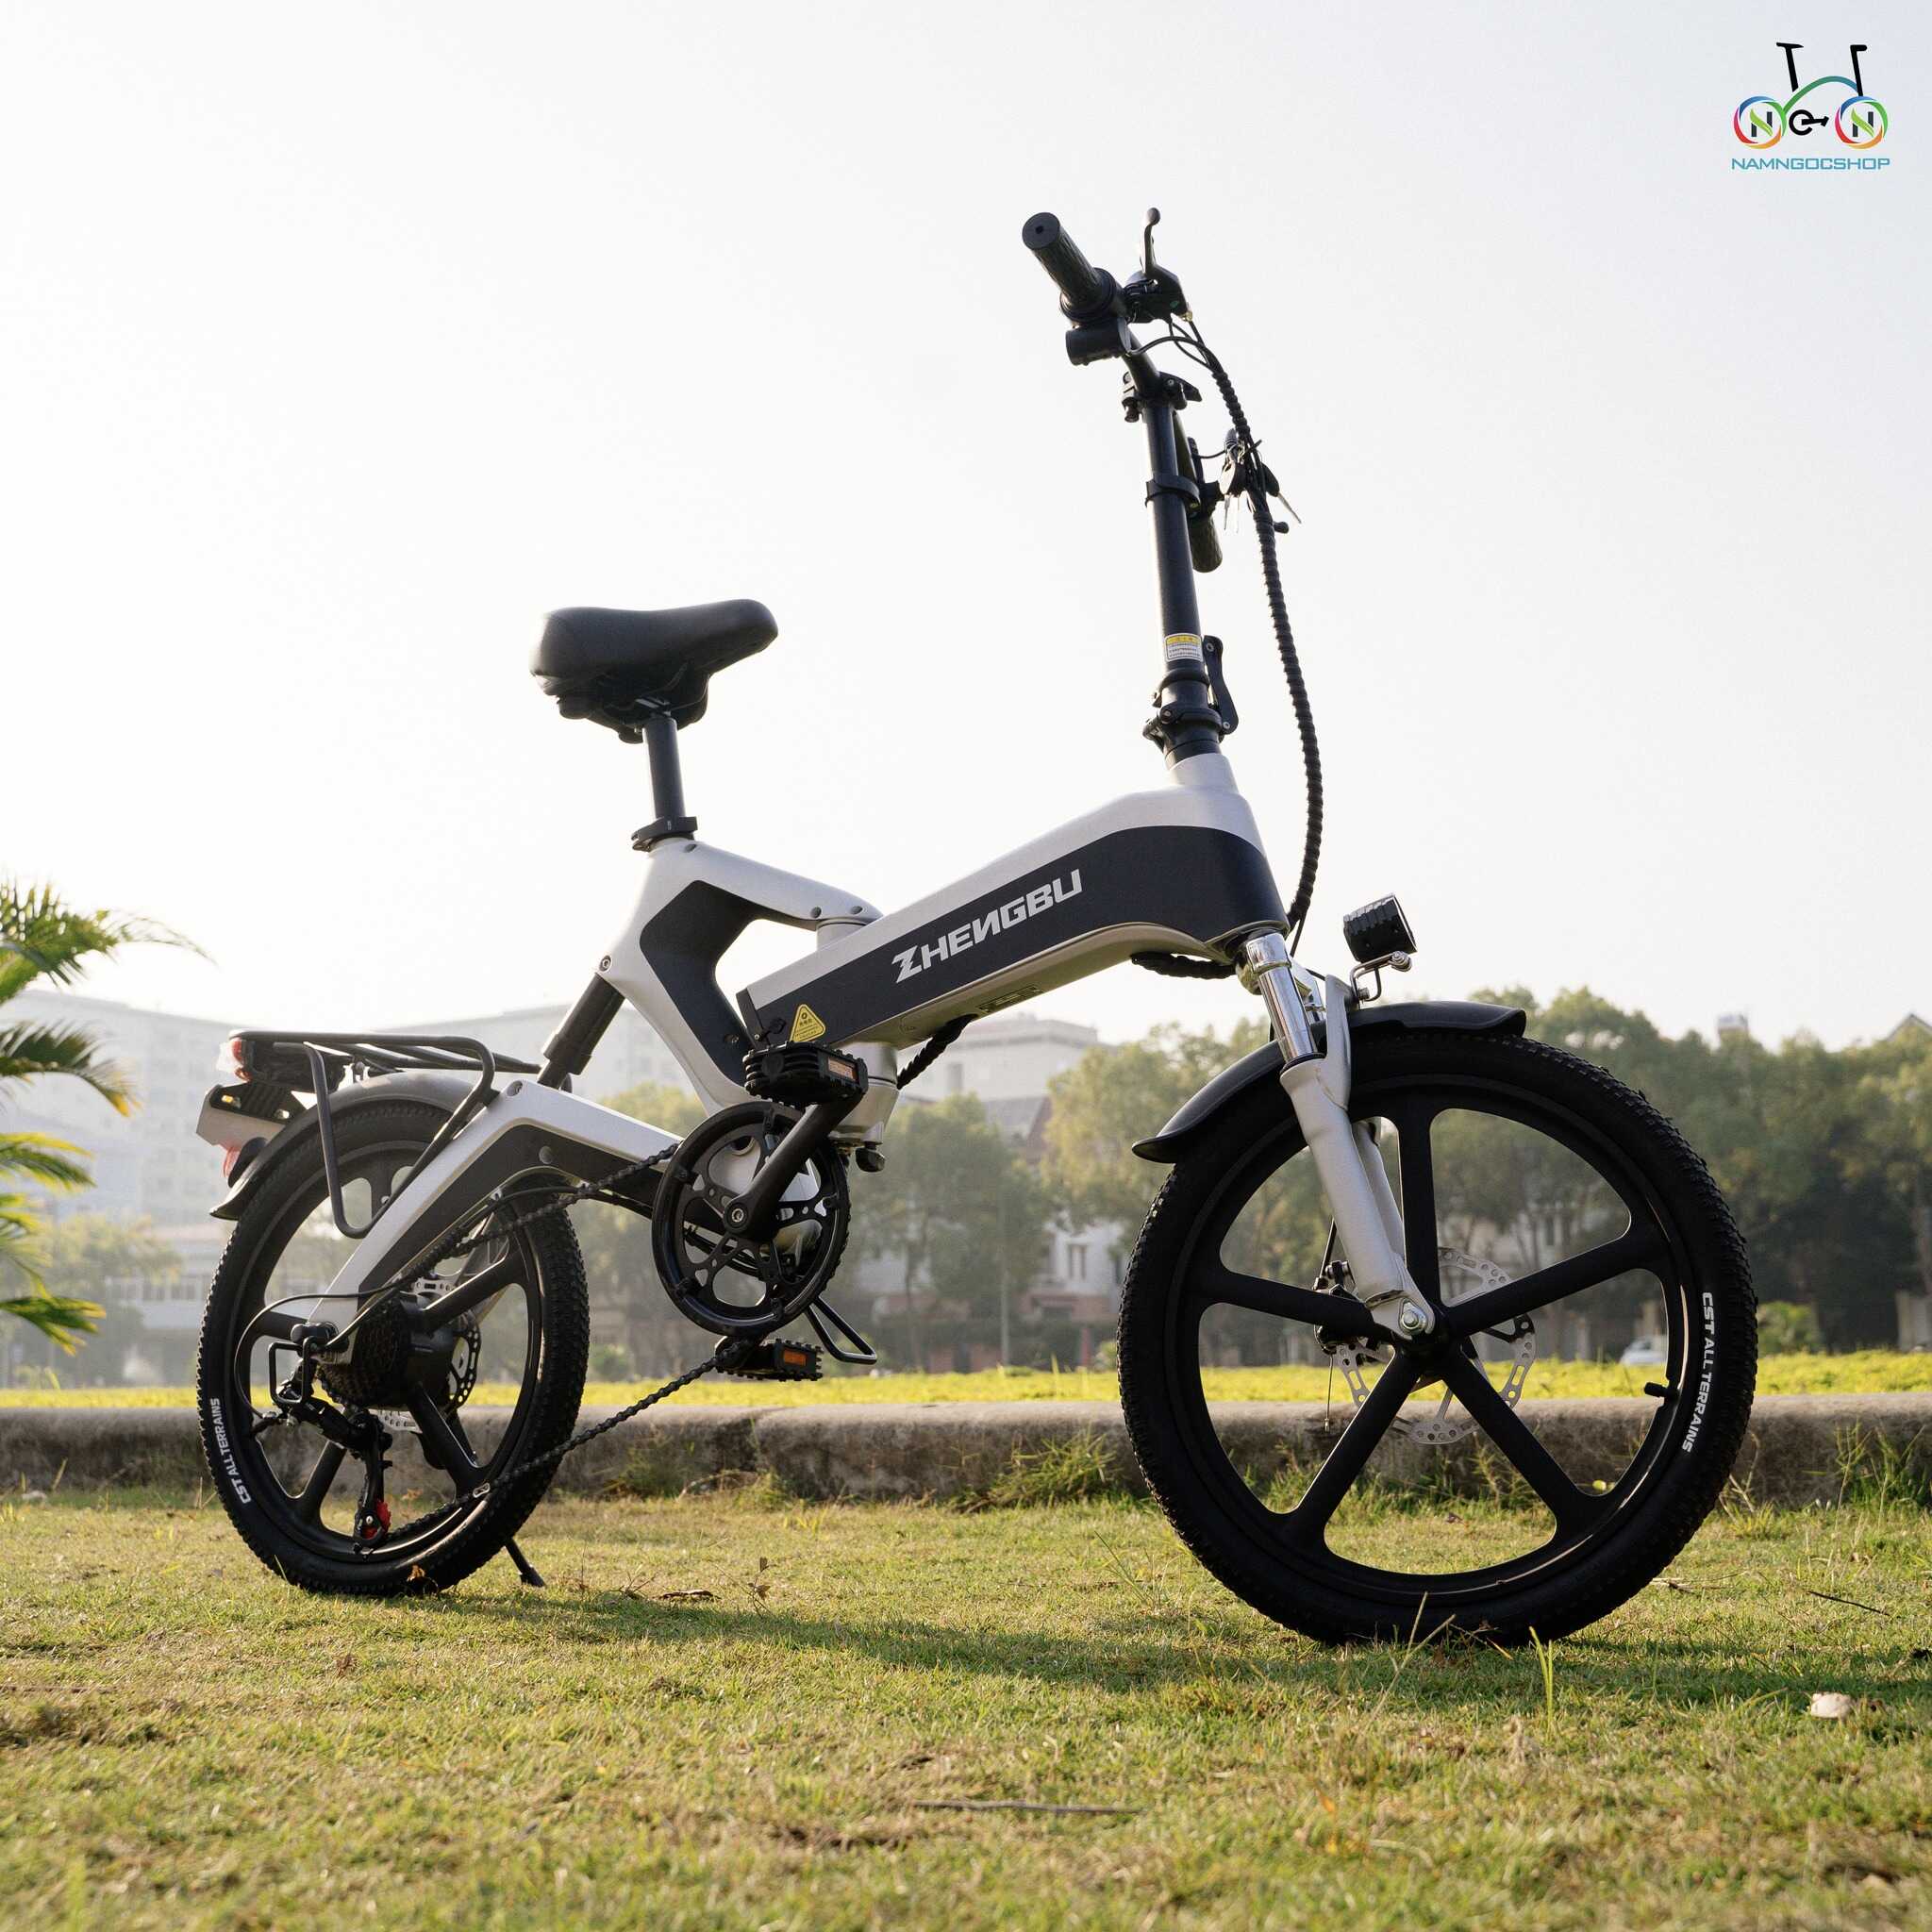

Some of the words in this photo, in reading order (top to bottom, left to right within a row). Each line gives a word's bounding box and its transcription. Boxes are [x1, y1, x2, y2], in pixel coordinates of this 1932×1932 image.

[891, 868, 1083, 983] ZHENGBU
[1702, 1291, 1715, 1334] CST
[1703, 1337, 1715, 1369] ALL
[210, 1397, 231, 1456] TERRAINS
[1682, 1373, 1712, 1453] TERRAINS
[224, 1454, 240, 1475] ALL
[231, 1477, 252, 1504] CST
